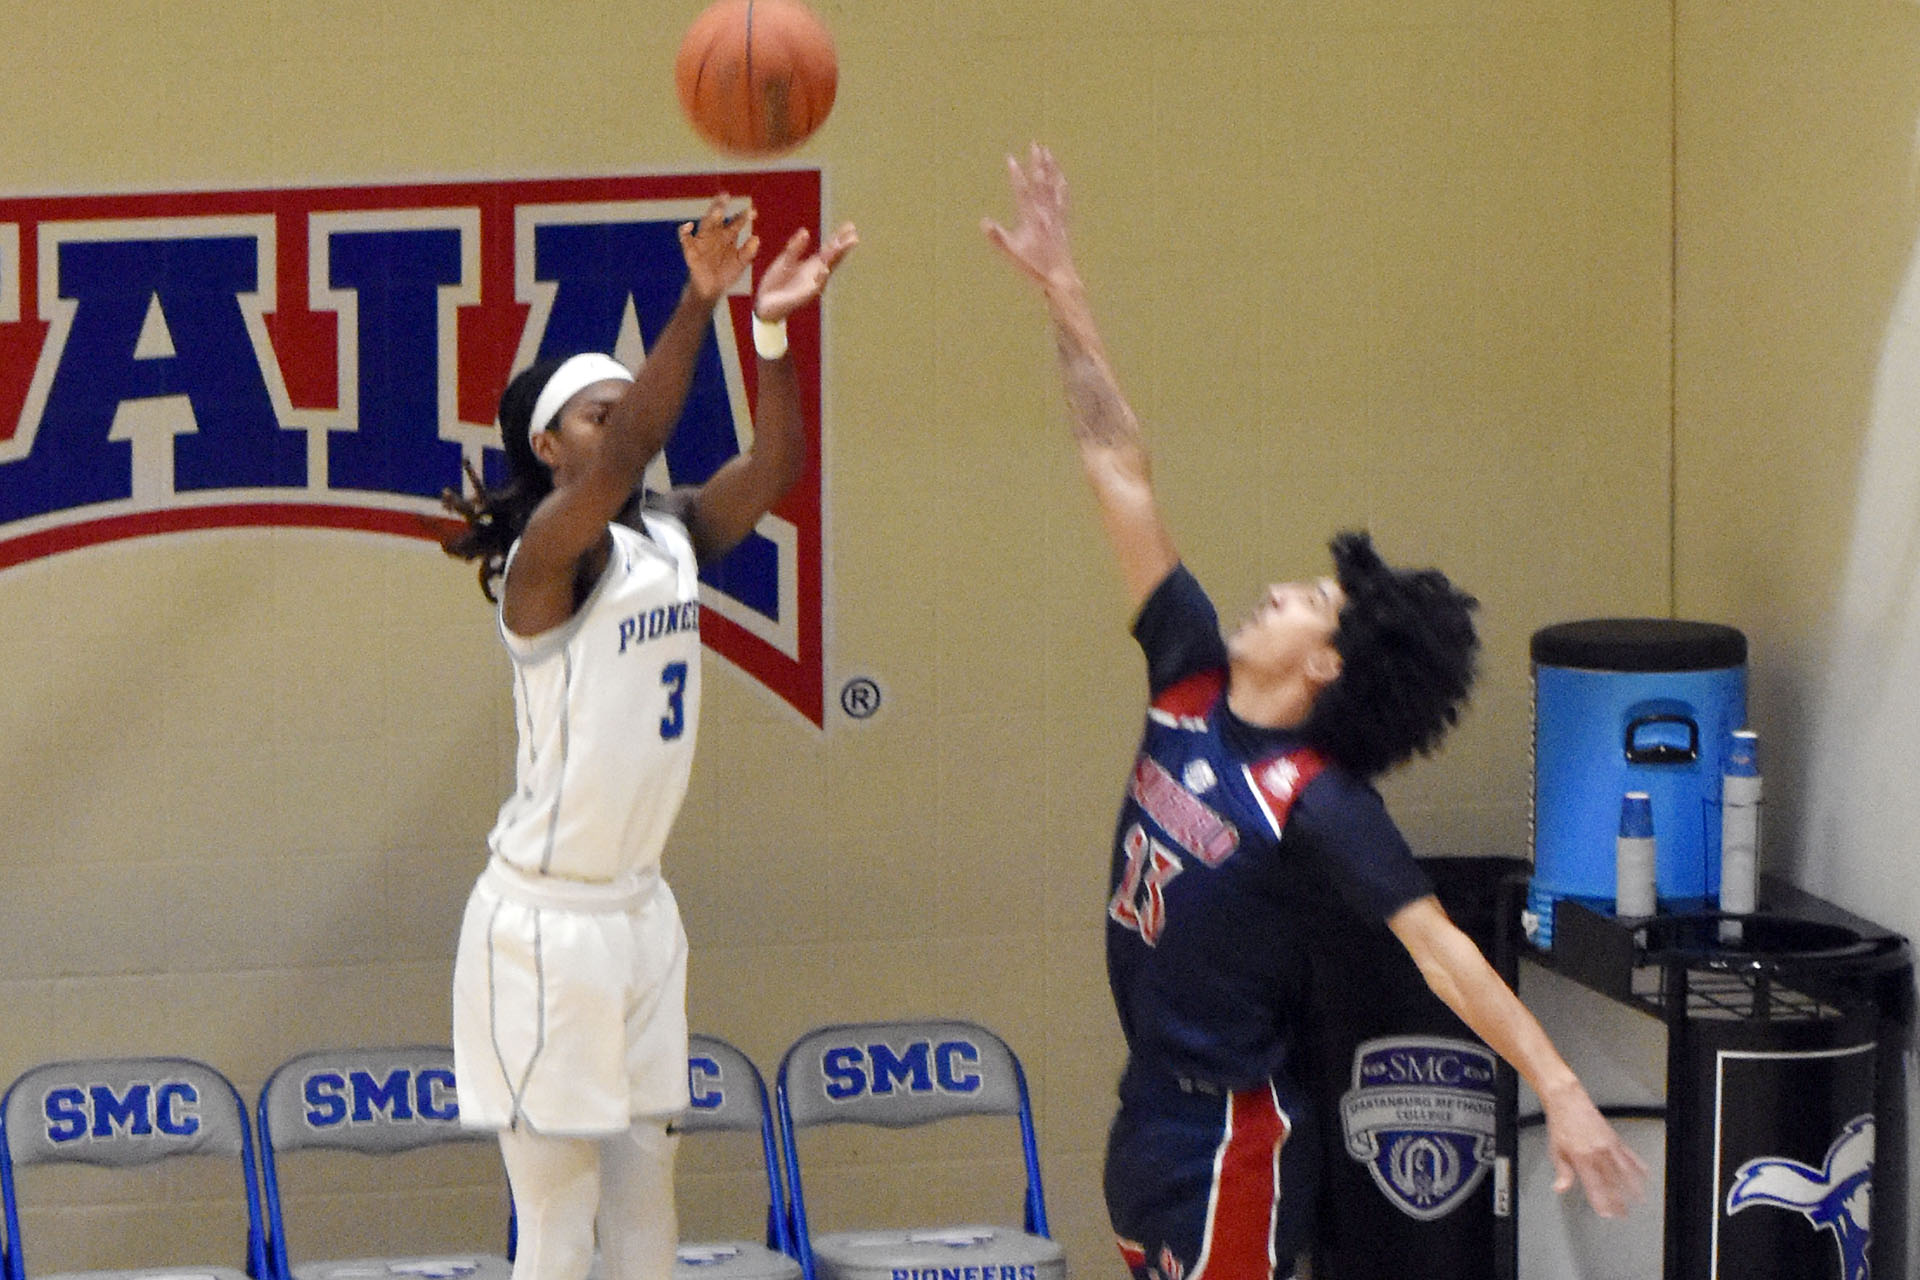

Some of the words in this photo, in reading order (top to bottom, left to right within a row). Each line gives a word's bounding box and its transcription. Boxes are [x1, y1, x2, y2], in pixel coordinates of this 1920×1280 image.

[0, 197, 799, 660] AIA
[659, 661, 688, 741] 3
[303, 1067, 460, 1128] SMC
[823, 1040, 982, 1101] SMC
[1388, 1052, 1461, 1083] SMC
[44, 1081, 202, 1143] SMC
[891, 1264, 1036, 1280] PIONEERS
